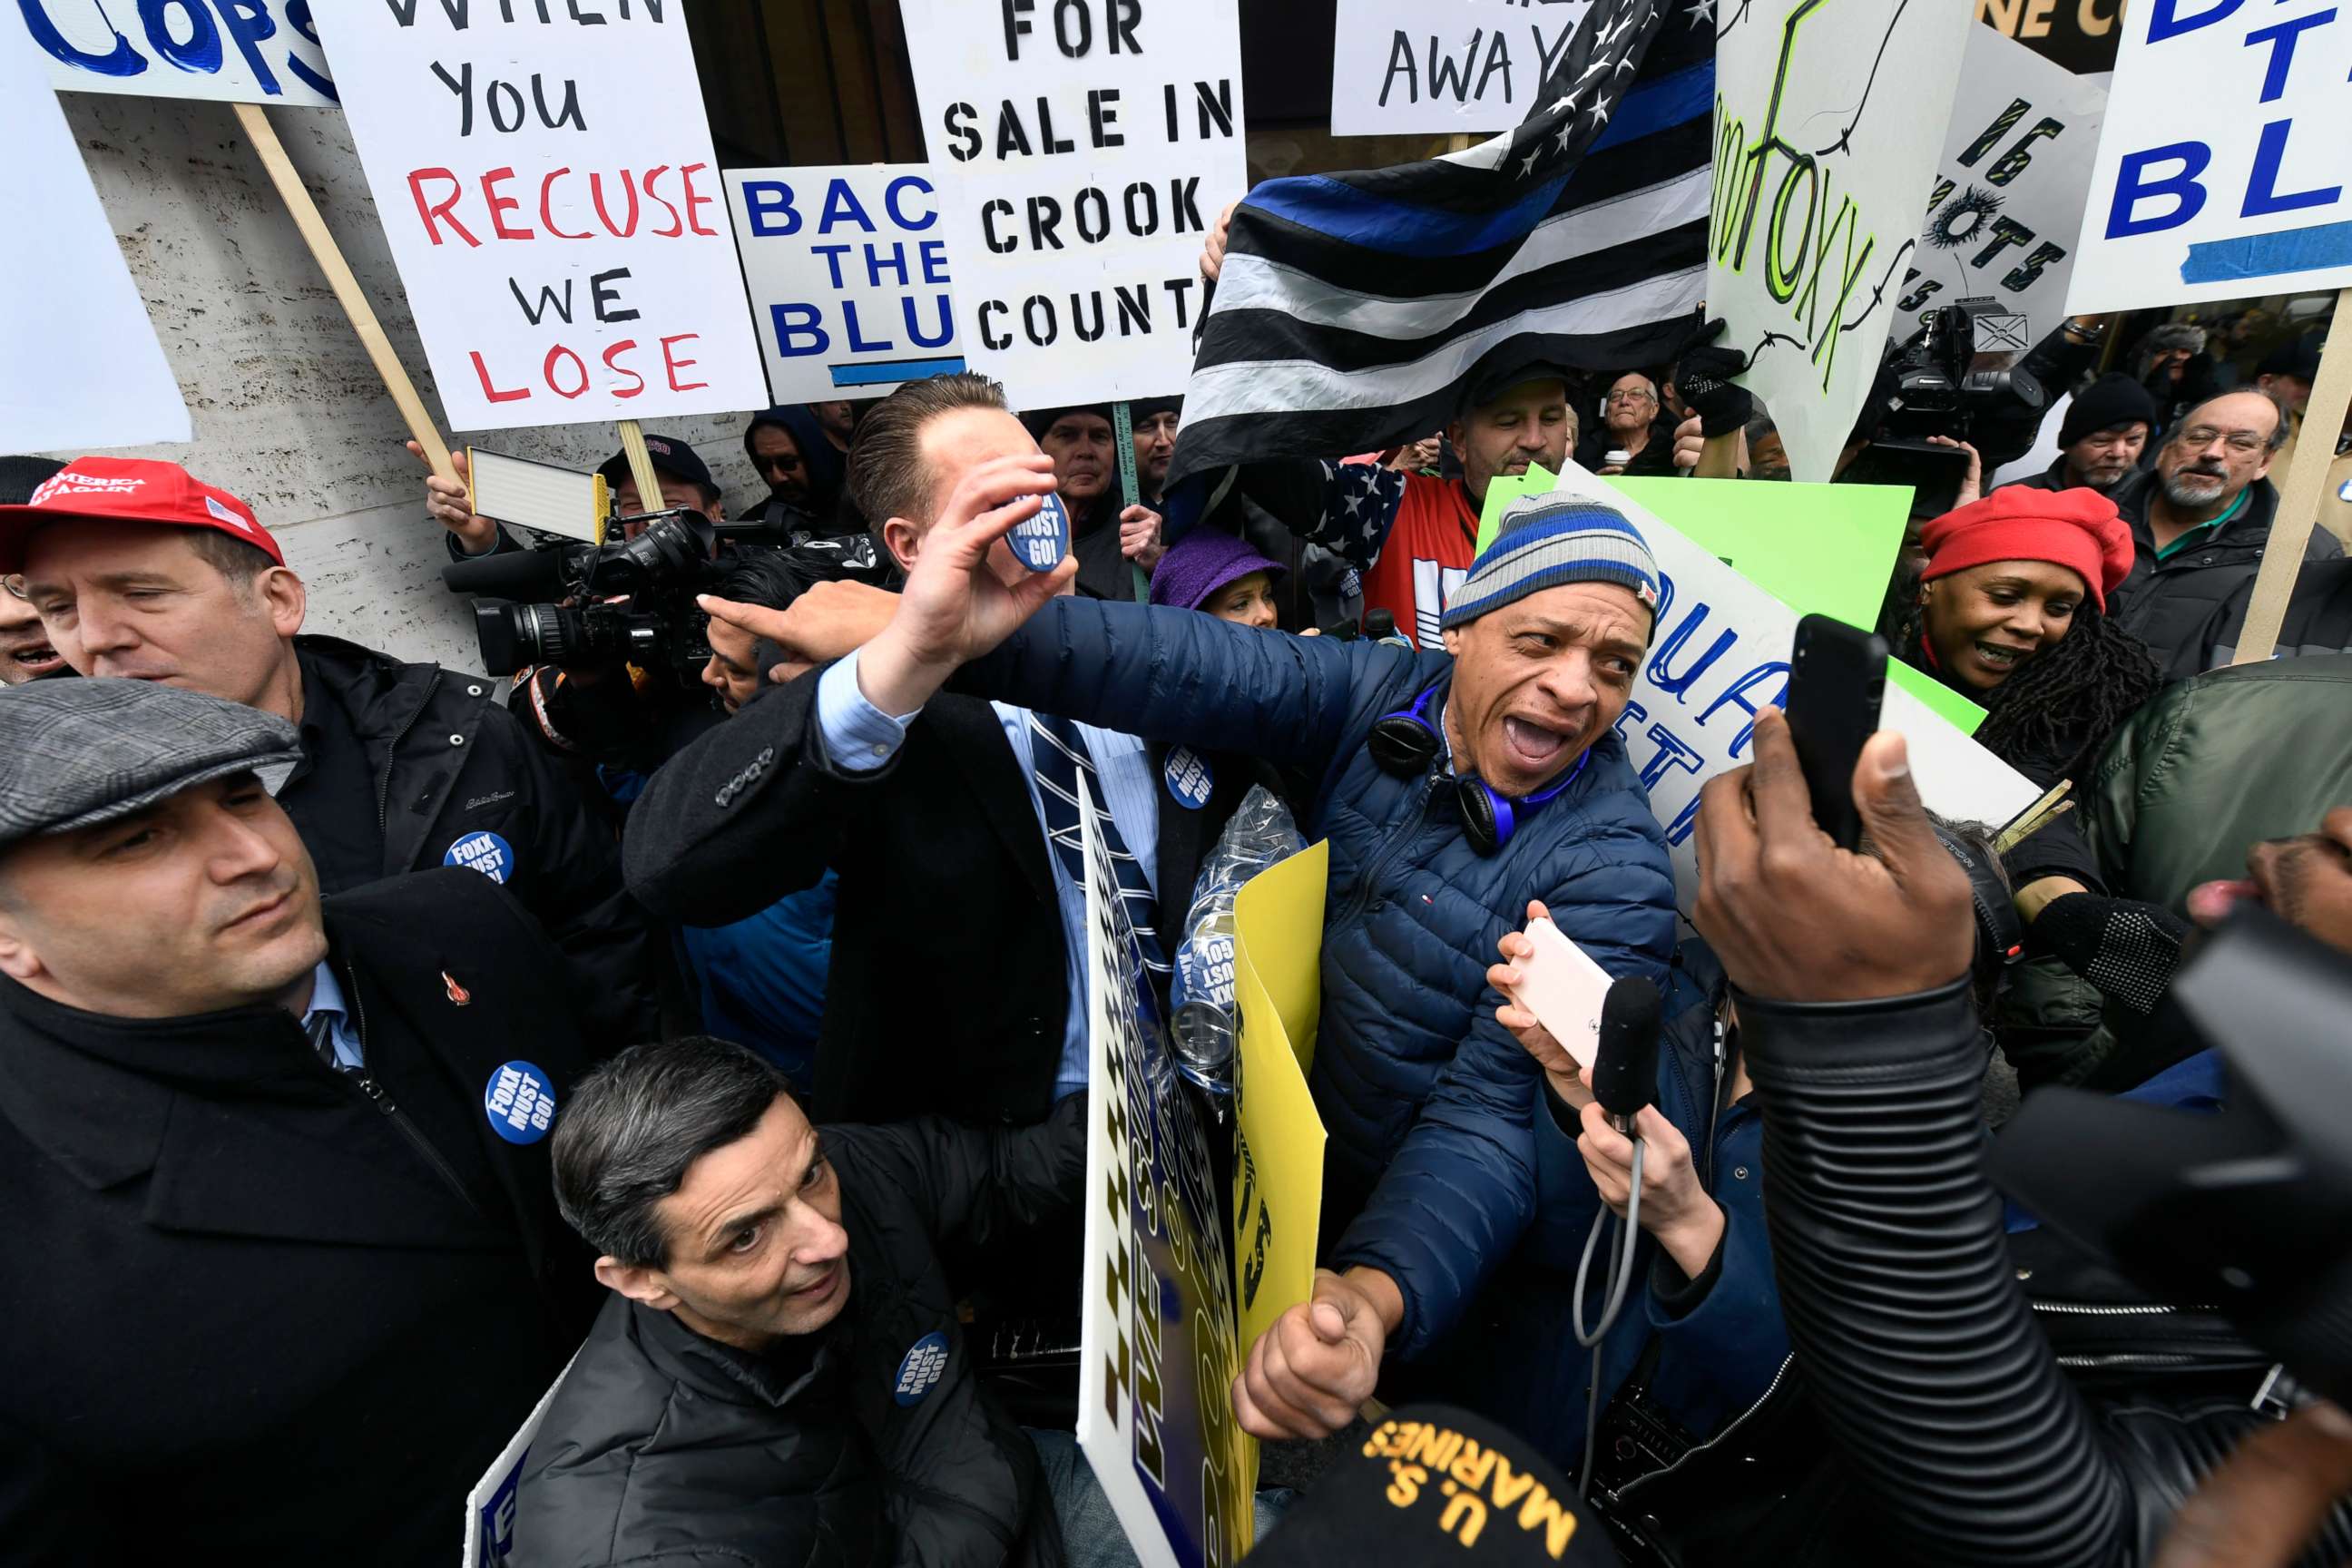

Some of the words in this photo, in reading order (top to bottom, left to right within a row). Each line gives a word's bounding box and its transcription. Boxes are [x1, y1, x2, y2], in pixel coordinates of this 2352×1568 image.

[1003, 0, 1142, 61] FOR
[1378, 20, 1574, 107] AWAY
[430, 60, 587, 136] YOU
[944, 88, 1125, 162] SALE
[1164, 79, 1233, 142] IN
[1956, 98, 2065, 188] 16
[407, 163, 719, 248] RECUSE
[981, 177, 1205, 253] CROOK
[810, 240, 951, 289] THE
[508, 268, 641, 326] WE
[469, 334, 709, 404] LOSE
[54, 483, 136, 495] AGAIN
[1028, 538, 1058, 566] GO!
[1178, 755, 1205, 798] MUST
[1193, 774, 1213, 804] GO!
[452, 833, 496, 865] FOXX
[1202, 962, 1235, 989] UST
[488, 1064, 523, 1117] FOXX
[507, 1072, 541, 1132] MUST
[531, 1093, 555, 1131] GO!
[897, 1348, 926, 1393] FOXX
[909, 1344, 939, 1396] MUST
[927, 1352, 948, 1384] GO!
[1134, 1229, 1165, 1491] WE
[1362, 1421, 1578, 1561] MARINES
